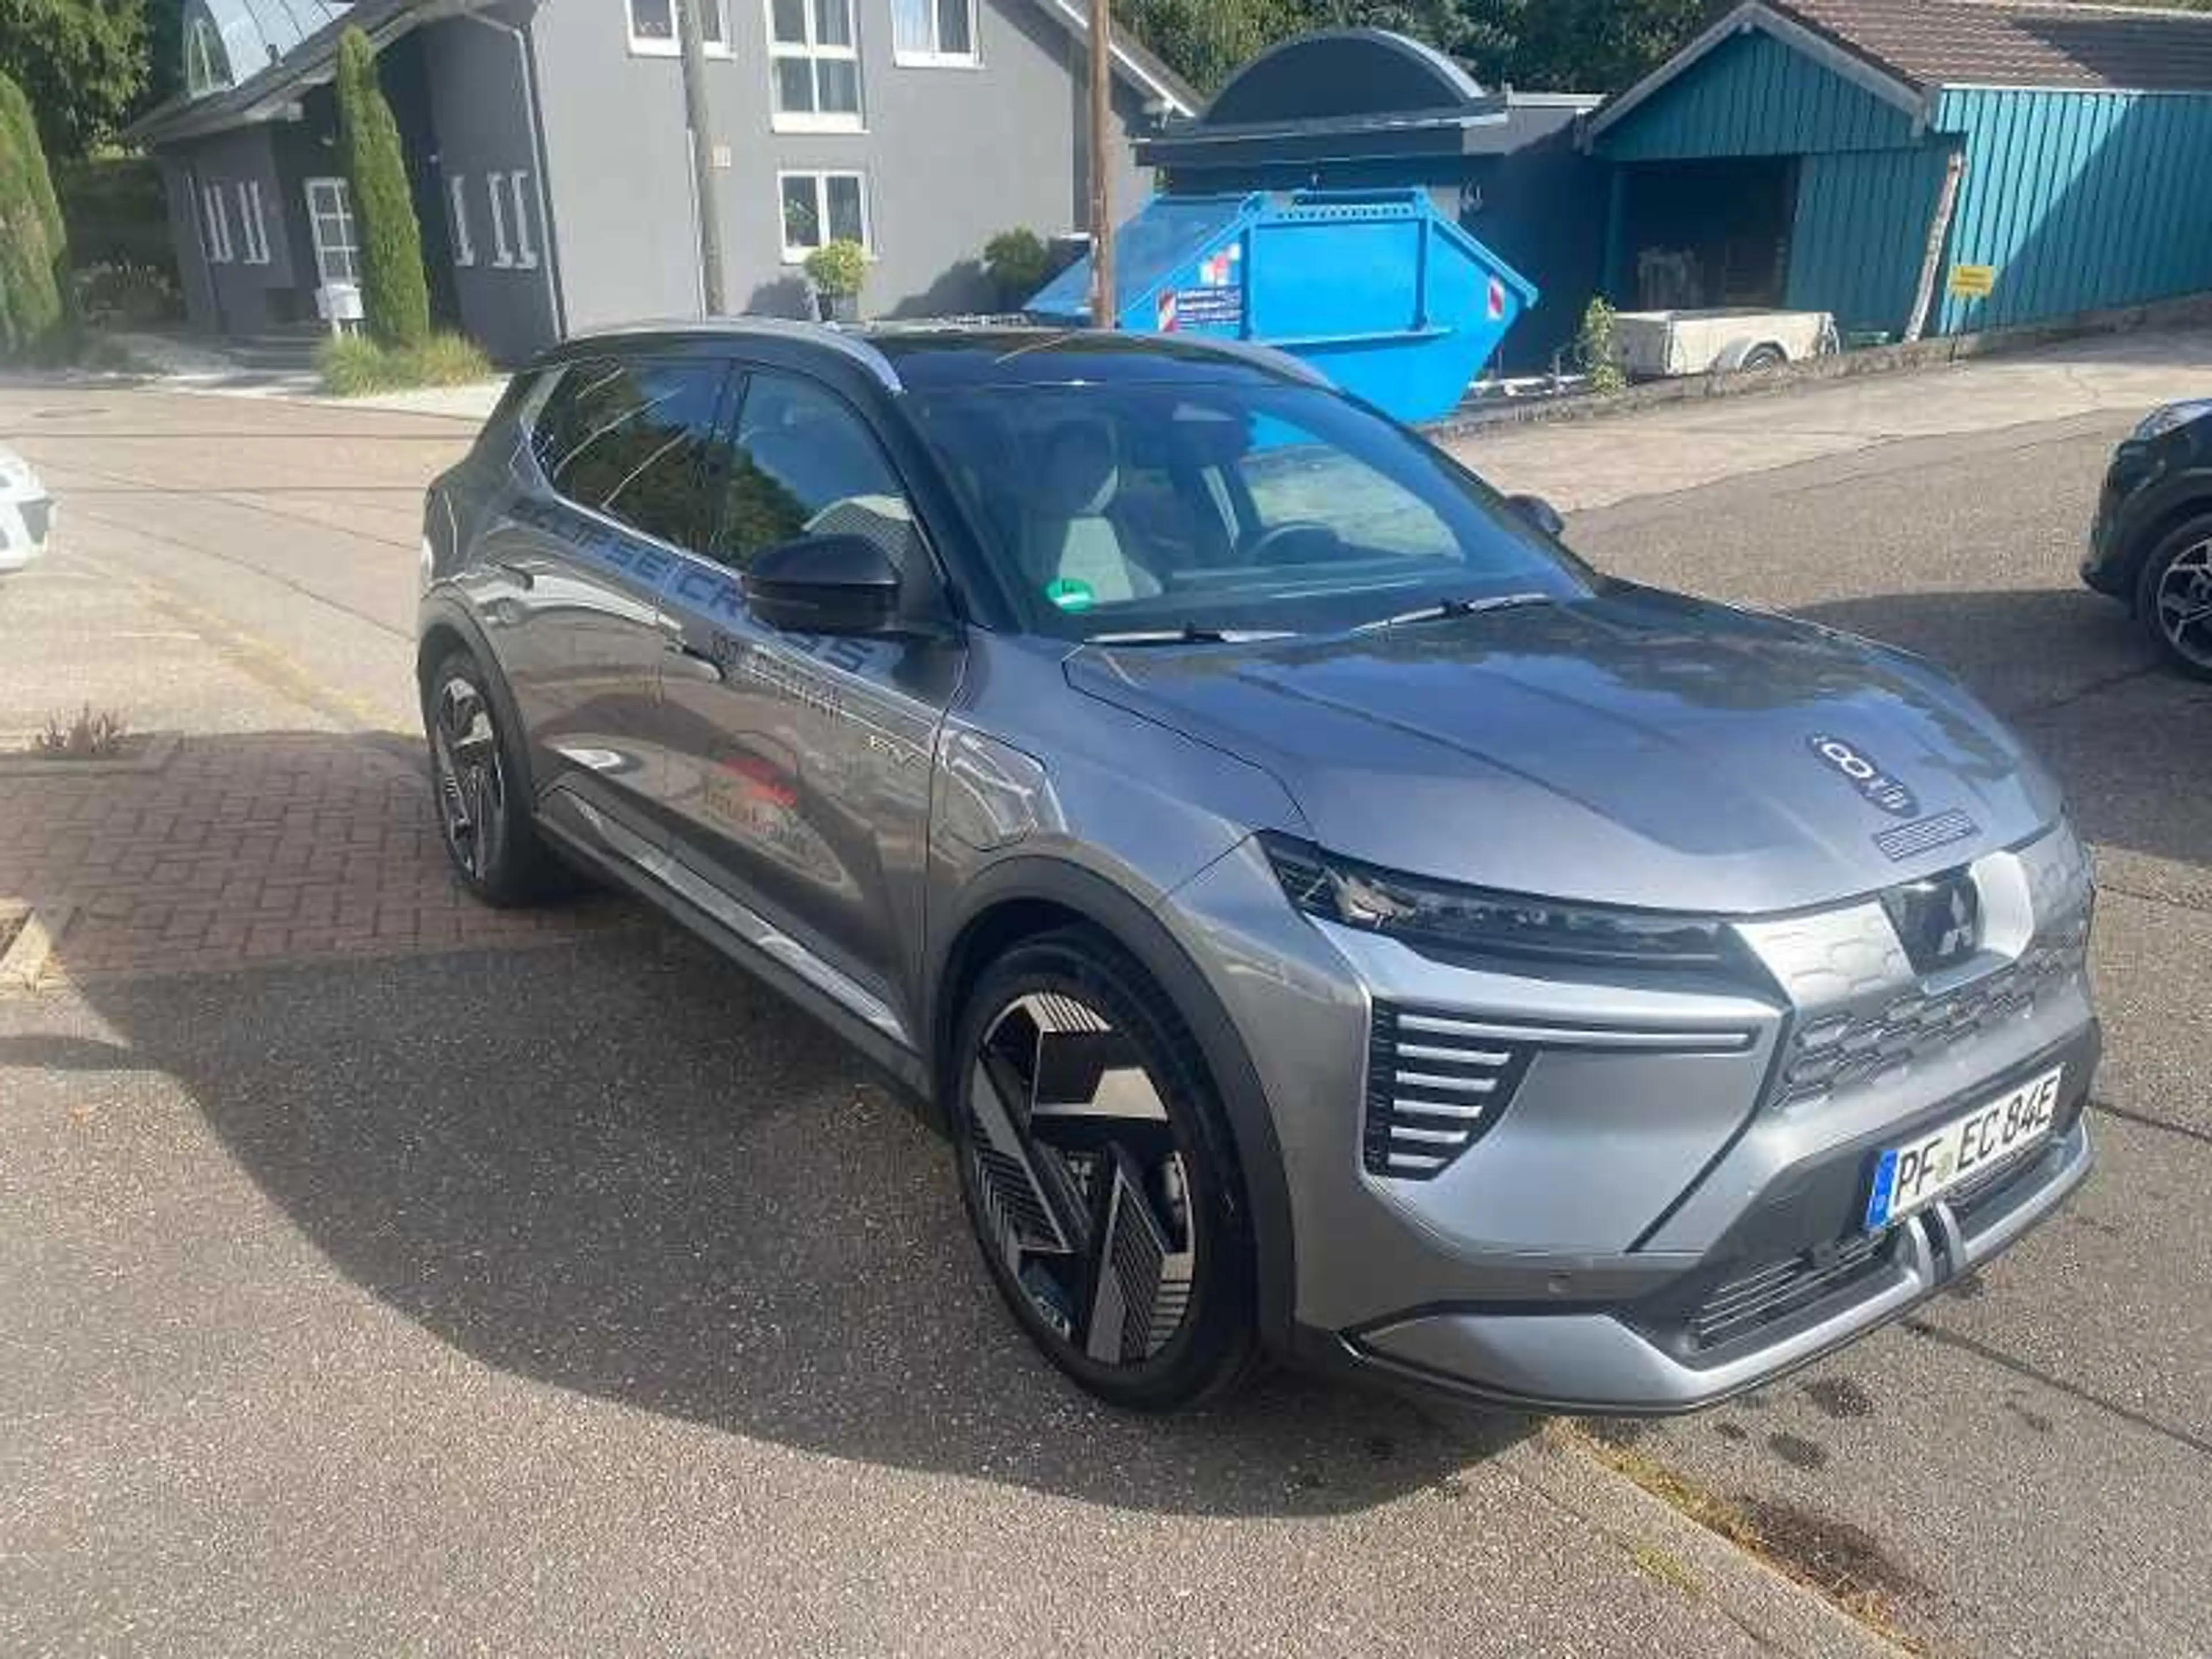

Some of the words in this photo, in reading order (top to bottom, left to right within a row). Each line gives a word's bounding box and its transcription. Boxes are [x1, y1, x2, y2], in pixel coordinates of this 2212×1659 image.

[1894, 1137, 1944, 1207] PF
[1956, 1108, 2000, 1172] EC
[2002, 1075, 2059, 1144] 84E
